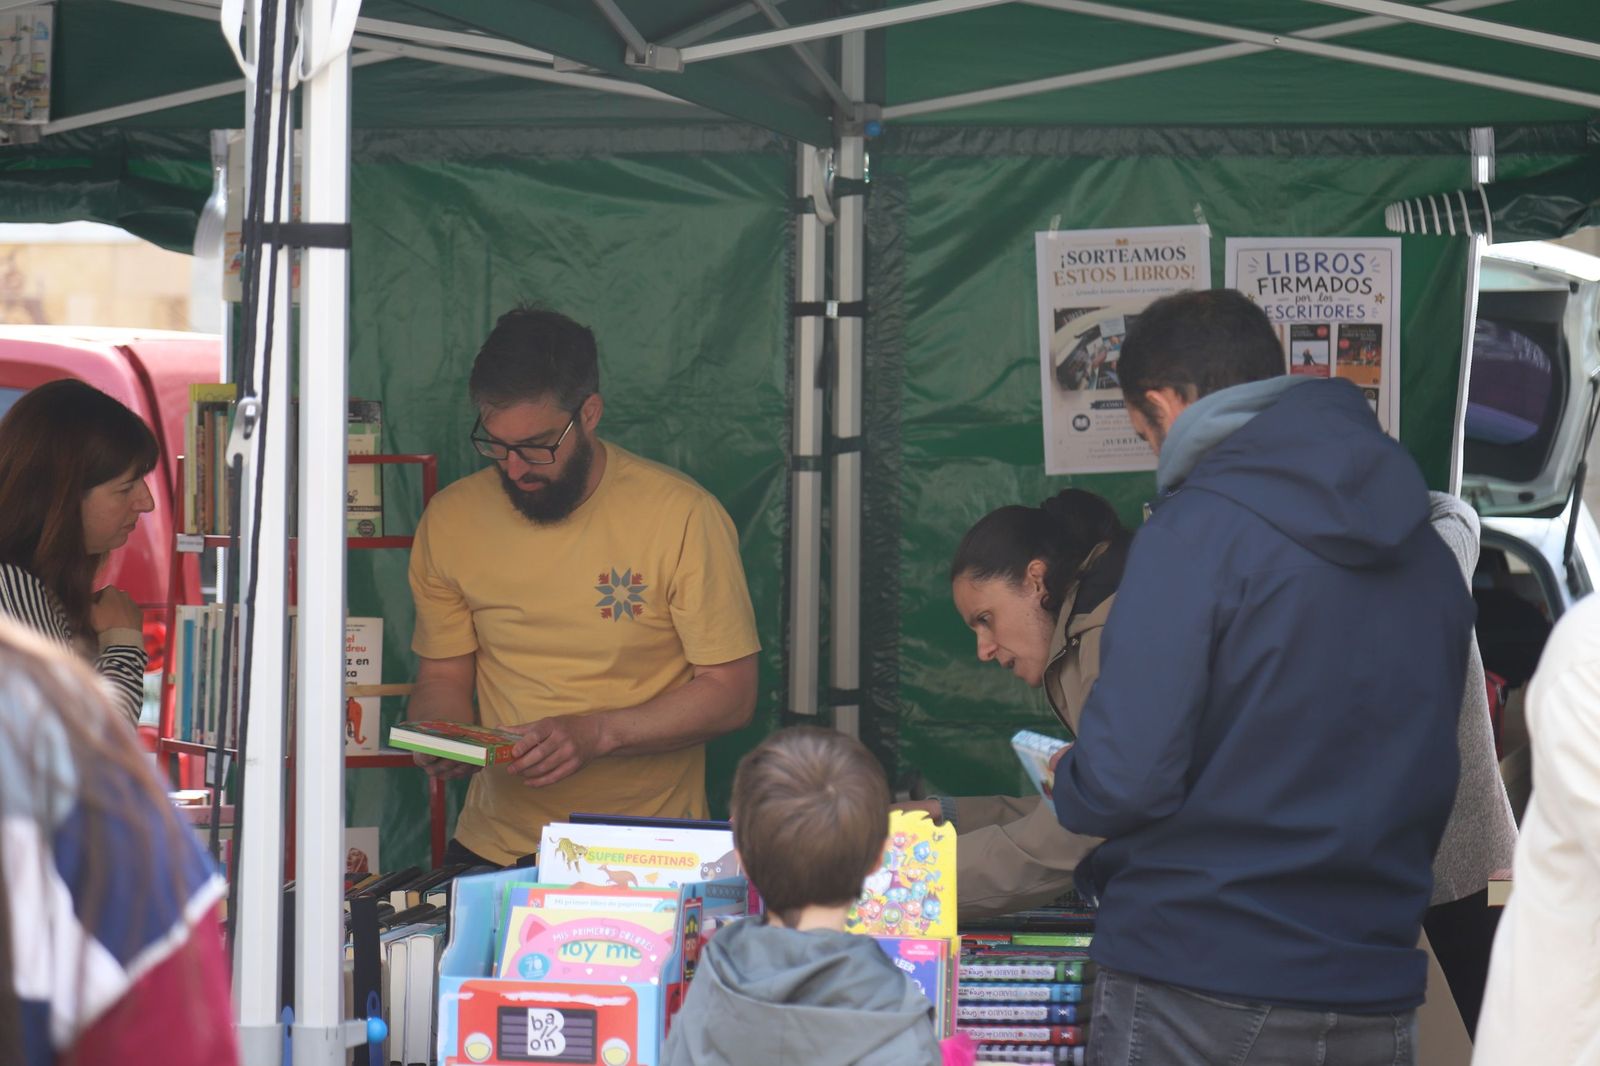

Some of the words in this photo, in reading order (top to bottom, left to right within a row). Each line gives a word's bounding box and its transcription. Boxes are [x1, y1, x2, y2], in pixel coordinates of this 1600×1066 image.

[1061, 246, 1187, 268] ¡SORTEAMOS
[1266, 252, 1366, 275] LIBROS
[1054, 266, 1117, 286] ESTOS
[1123, 264, 1196, 282] LIBROS!
[1256, 275, 1374, 295] FIRMADOS
[1295, 296, 1313, 305] por
[1317, 292, 1334, 303] los
[1264, 303, 1366, 320] ESCRITORES
[355, 658, 370, 667] en
[587, 850, 695, 868] SUPERPEGATINAS
[552, 930, 569, 943] MIS
[572, 927, 616, 937] PRIMEROS
